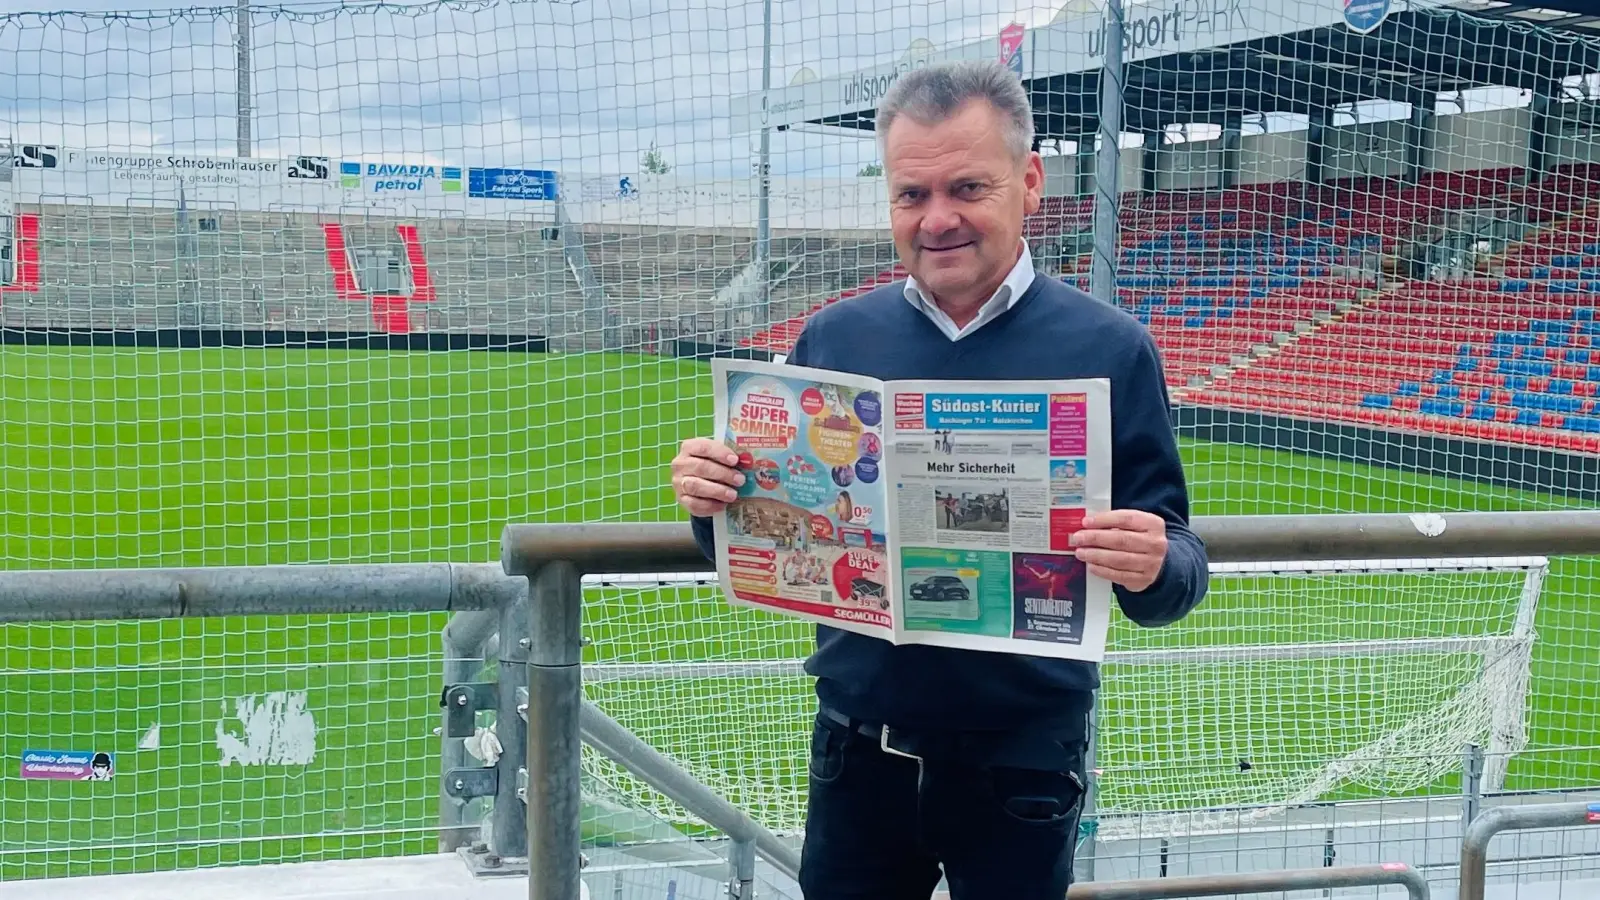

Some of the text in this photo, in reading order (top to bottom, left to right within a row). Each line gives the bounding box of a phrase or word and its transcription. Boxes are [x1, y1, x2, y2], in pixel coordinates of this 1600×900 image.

[69, 152, 278, 172] Fmengruppe Schrobenhauser
[375, 179, 422, 192] petrol
[931, 398, 1041, 413] Südost-Kurier
[740, 404, 788, 424] SUPER
[731, 417, 797, 440] SOMMER
[927, 461, 1016, 474] Mehr Sicherheit
[847, 551, 881, 564] SUPER
[848, 558, 876, 572] DEAL
